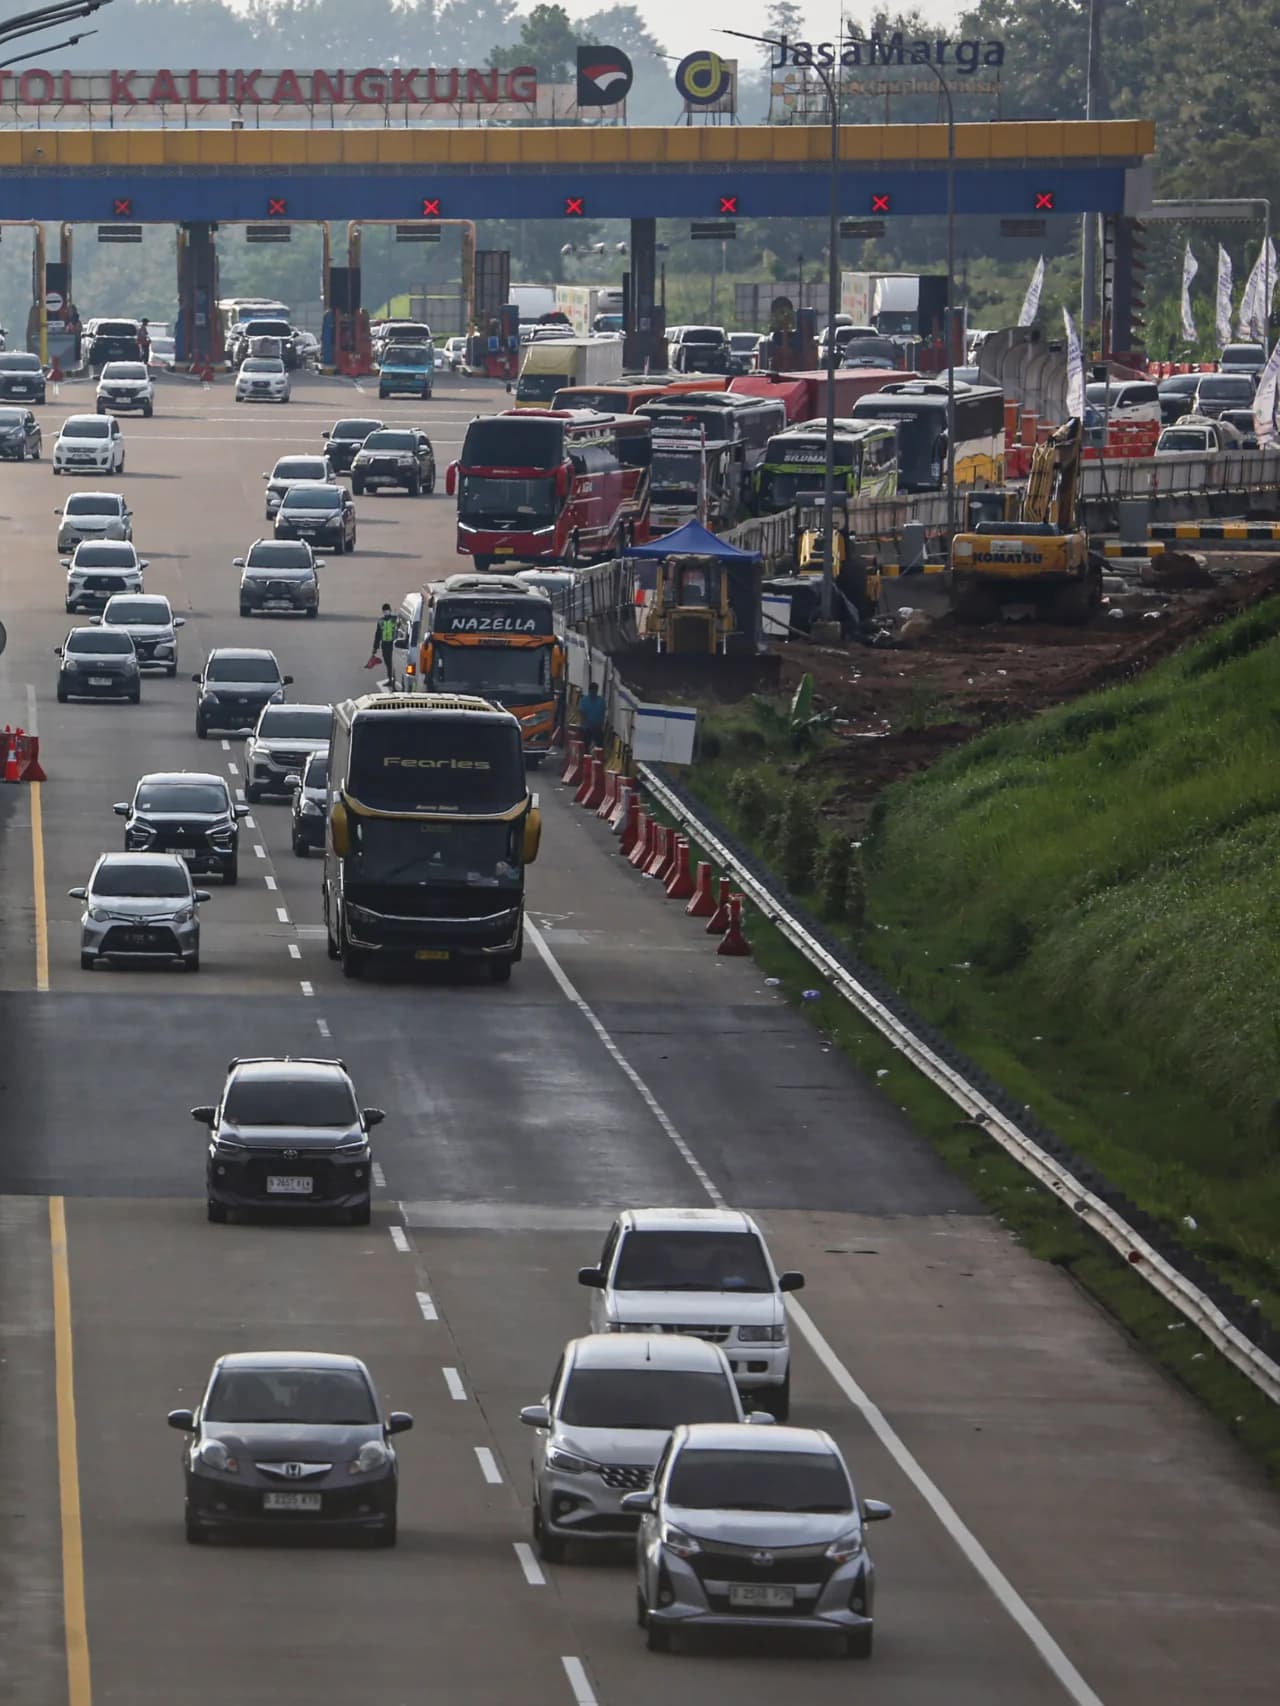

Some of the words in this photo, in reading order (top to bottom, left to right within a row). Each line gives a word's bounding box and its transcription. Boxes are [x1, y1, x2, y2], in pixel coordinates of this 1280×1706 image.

[109, 66, 537, 106] KALIKANGKUNG
[784, 453, 827, 463] SILUMA
[973, 552, 1043, 565] KOMATSU
[451, 617, 536, 632] NAZELLA
[383, 755, 492, 771] Fearles
